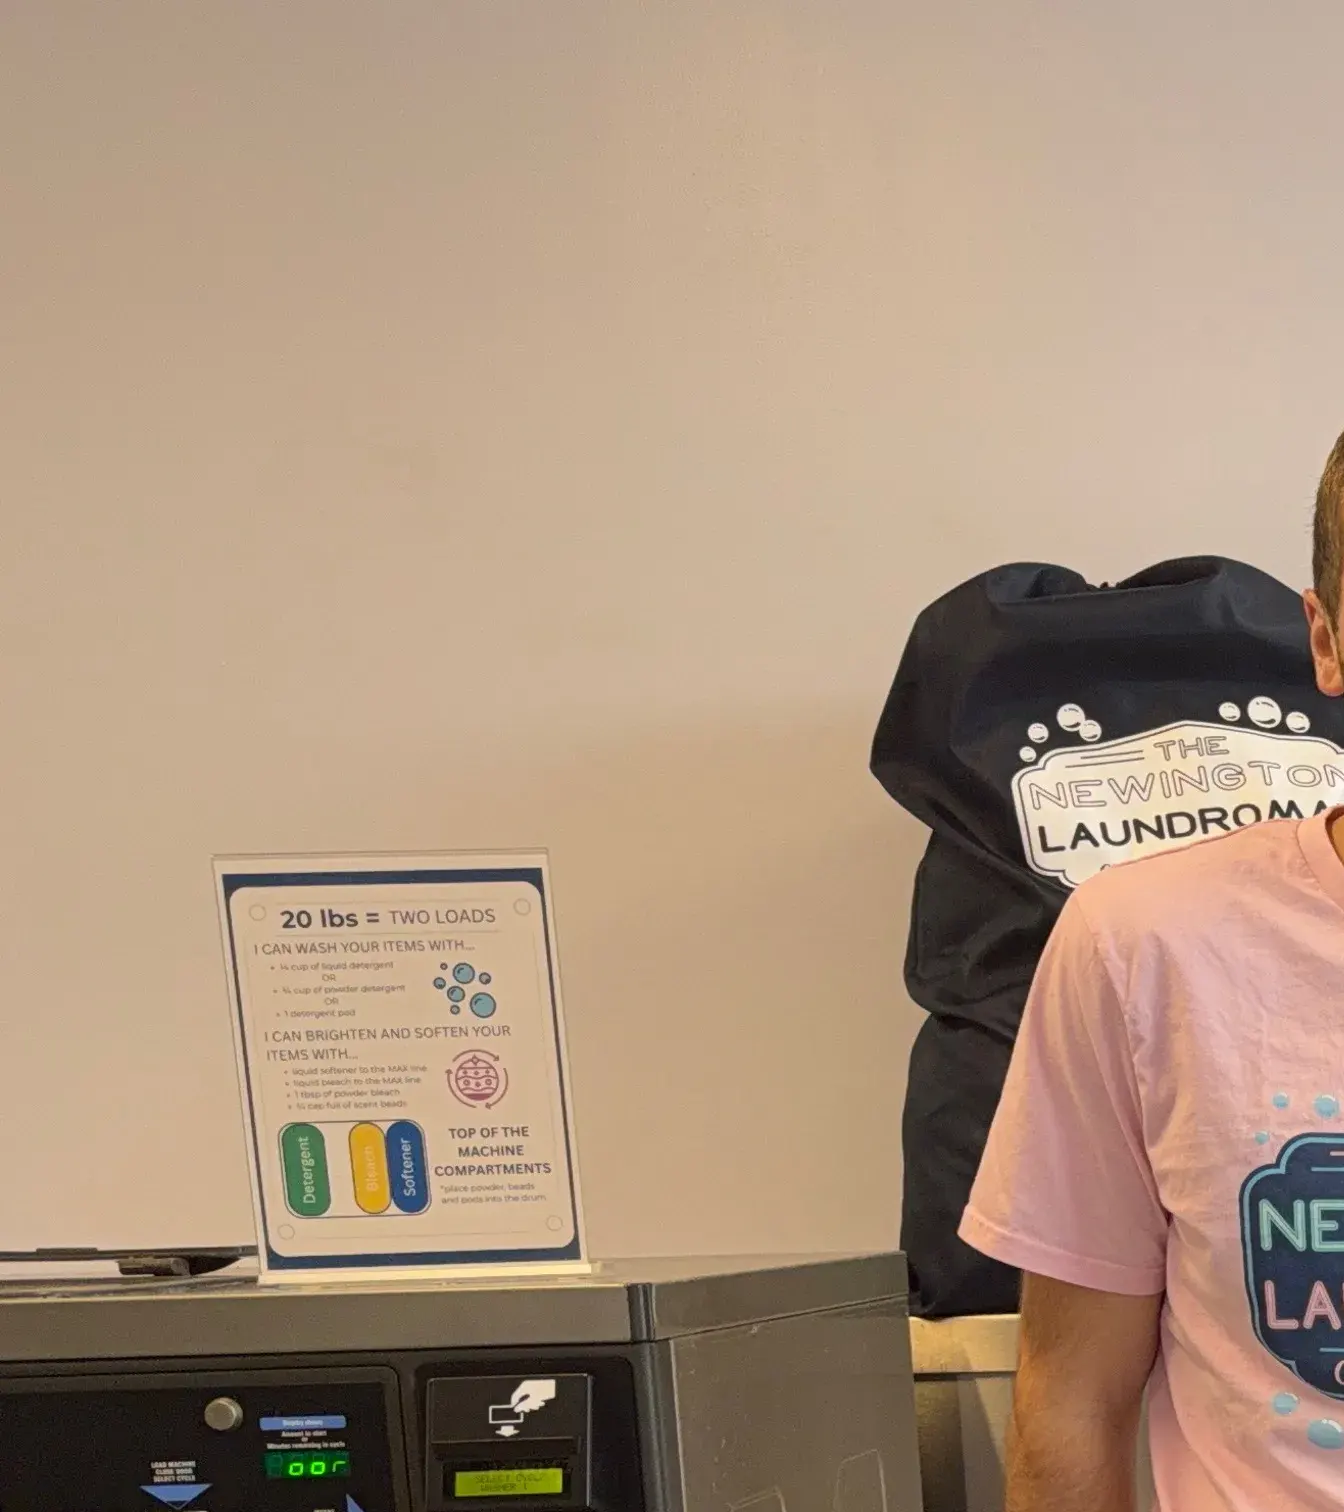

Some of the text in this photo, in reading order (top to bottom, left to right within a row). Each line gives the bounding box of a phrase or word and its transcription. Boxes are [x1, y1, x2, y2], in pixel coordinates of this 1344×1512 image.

[1153, 736, 1229, 761] THE
[1038, 799, 1328, 853] LAUNDROM
[280, 910, 312, 929] 20
[320, 909, 358, 928] lbs
[389, 910, 430, 925] TWO
[436, 908, 496, 924] LOADS
[262, 943, 292, 955] CAN
[296, 942, 337, 954] WASH
[340, 941, 379, 953] YOUR
[383, 940, 425, 952] ITEMS
[321, 962, 347, 971] liquid
[349, 961, 393, 971] detergent
[322, 973, 336, 981] OR
[293, 987, 311, 995] cup
[324, 985, 358, 994] powder
[361, 984, 405, 994] detergent
[324, 997, 338, 1005] OR
[290, 1009, 336, 1019] detergent
[338, 1009, 356, 1018] pod
[272, 1030, 301, 1042] CAN
[305, 1028, 377, 1041] BRIGHTEN
[381, 1028, 410, 1039] AND
[414, 1026, 469, 1039] SOFTEN
[472, 1025, 511, 1037] YOUR
[267, 1049, 308, 1061] ITEMS
[292, 1067, 318, 1076] liquid
[320, 1066, 357, 1075] softener
[370, 1065, 385, 1073] the
[293, 1079, 319, 1087] liquid
[322, 1078, 351, 1086] bleach
[334, 1089, 368, 1098] powder
[370, 1088, 400, 1096] bleach
[448, 1126, 529, 1139] TOP OF THE
[458, 1145, 524, 1157] MACHINE
[298, 1136, 316, 1204] Detergent
[365, 1145, 379, 1192] Bleach
[402, 1137, 416, 1197] Softener
[435, 1163, 552, 1176] COMPARTMENTS
